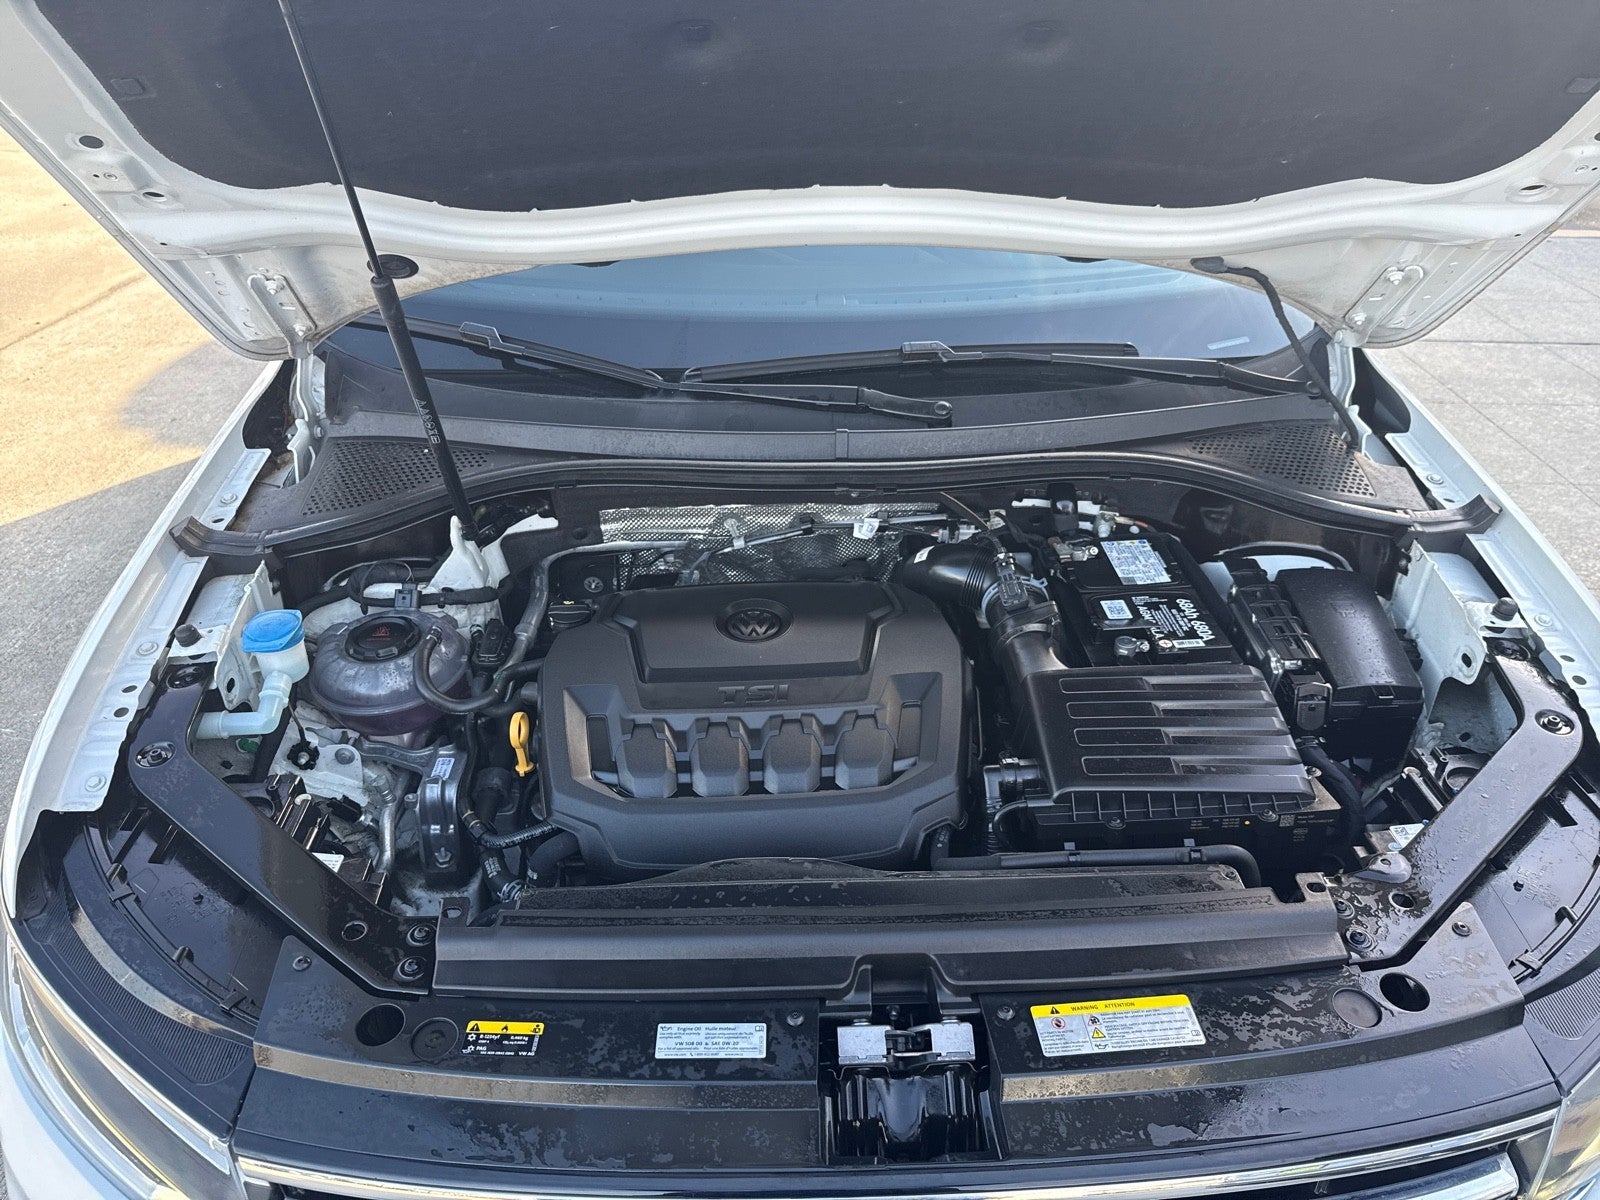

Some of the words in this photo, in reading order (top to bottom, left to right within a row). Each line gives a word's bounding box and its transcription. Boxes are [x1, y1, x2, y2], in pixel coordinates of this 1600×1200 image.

[1176, 598, 1200, 619] 68Ah
[1191, 620, 1216, 641] 680A
[718, 684, 789, 705] TSI
[1070, 1004, 1099, 1012] WARNING
